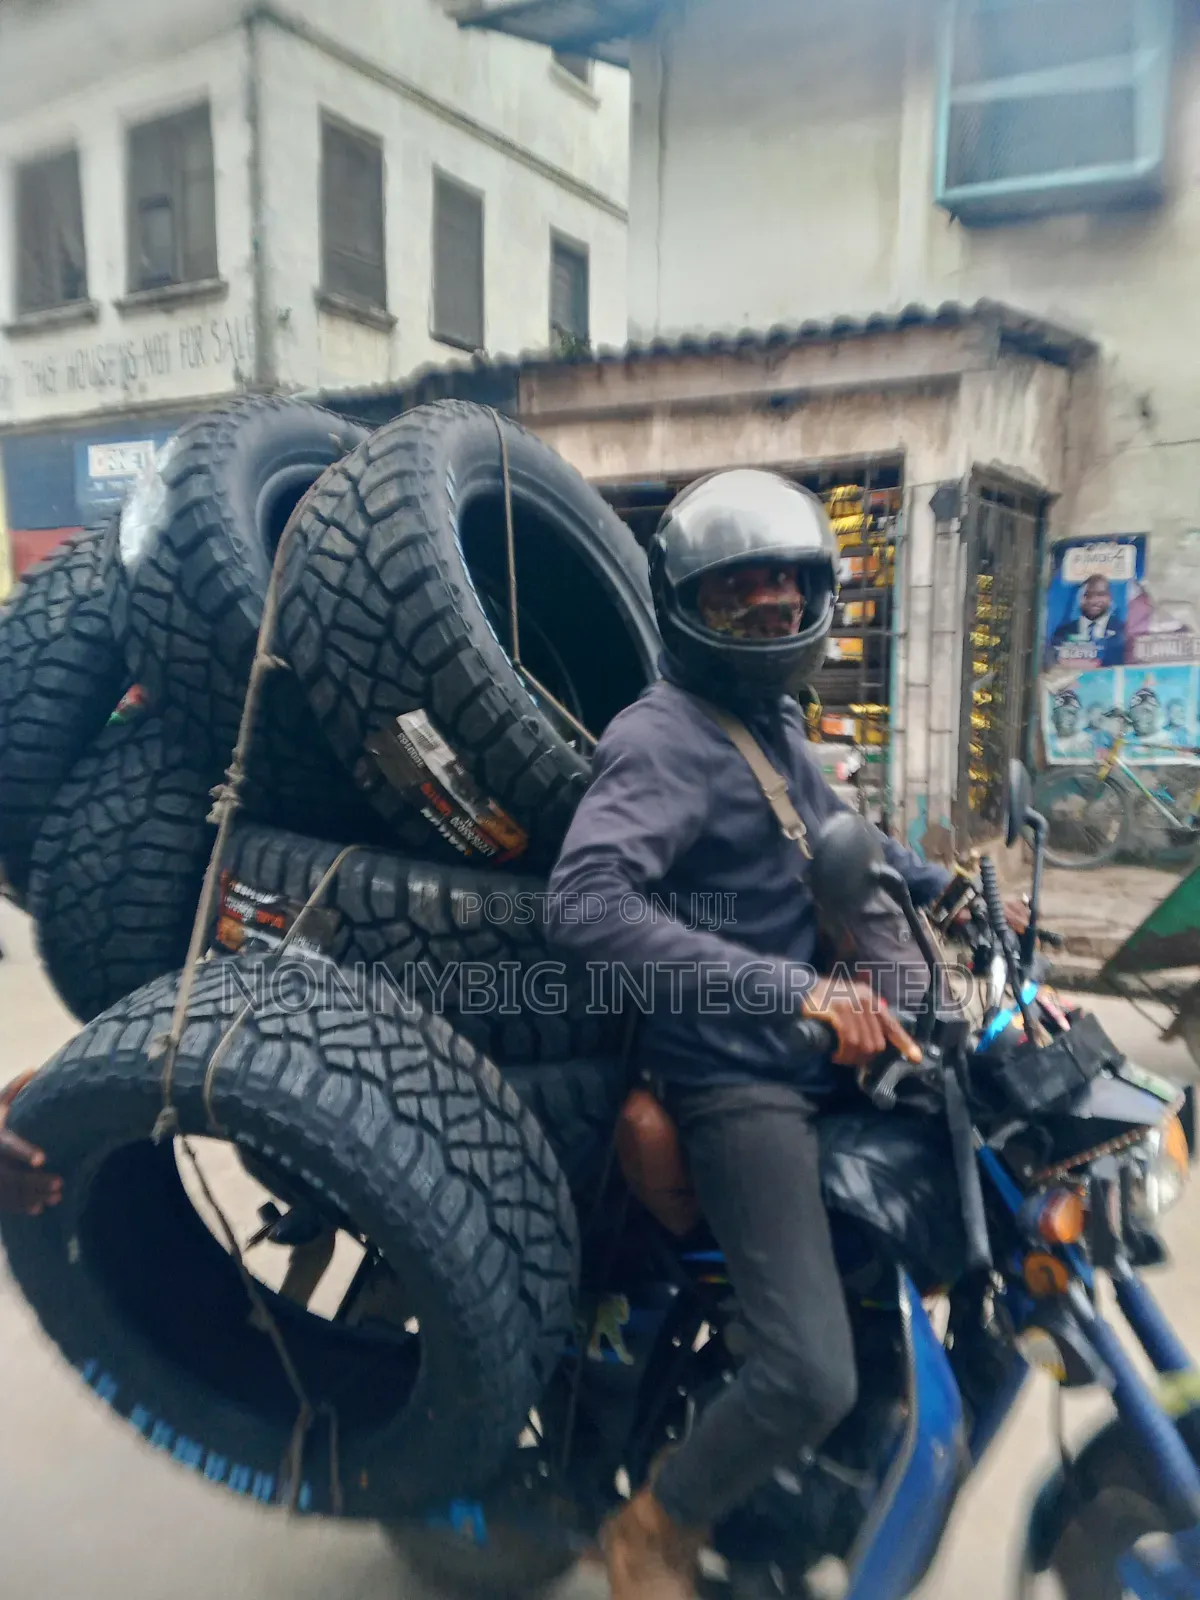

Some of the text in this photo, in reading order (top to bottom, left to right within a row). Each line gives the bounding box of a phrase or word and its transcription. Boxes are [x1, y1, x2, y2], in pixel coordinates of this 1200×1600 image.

[141, 329, 171, 376] NOT
[179, 323, 207, 369] FOR
[210, 316, 254, 366] SALE
